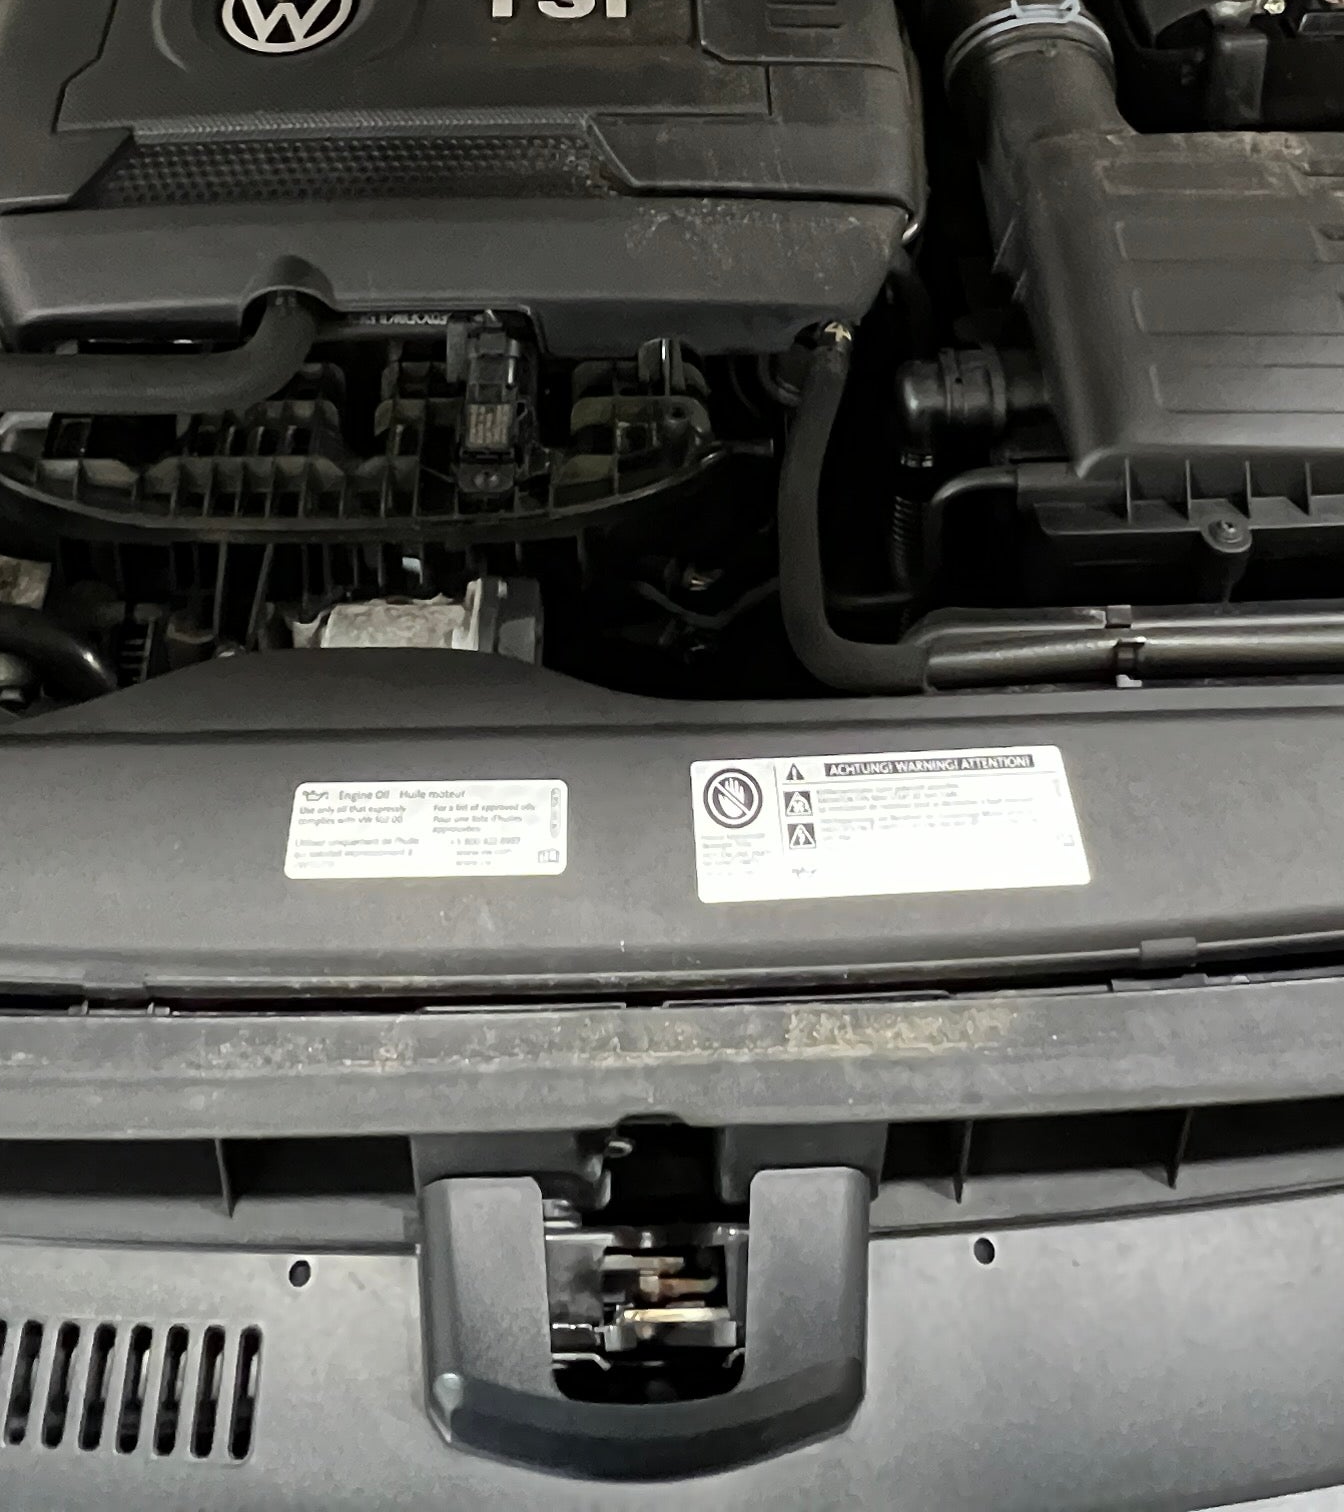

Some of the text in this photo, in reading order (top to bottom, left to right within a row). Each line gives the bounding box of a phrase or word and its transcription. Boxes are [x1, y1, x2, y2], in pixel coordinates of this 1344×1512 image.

[829, 754, 1030, 776] ACHTUNG! WARNING! ATTENTION!
[339, 790, 390, 802] Engine Oil
[399, 789, 466, 799] Huile moteur
